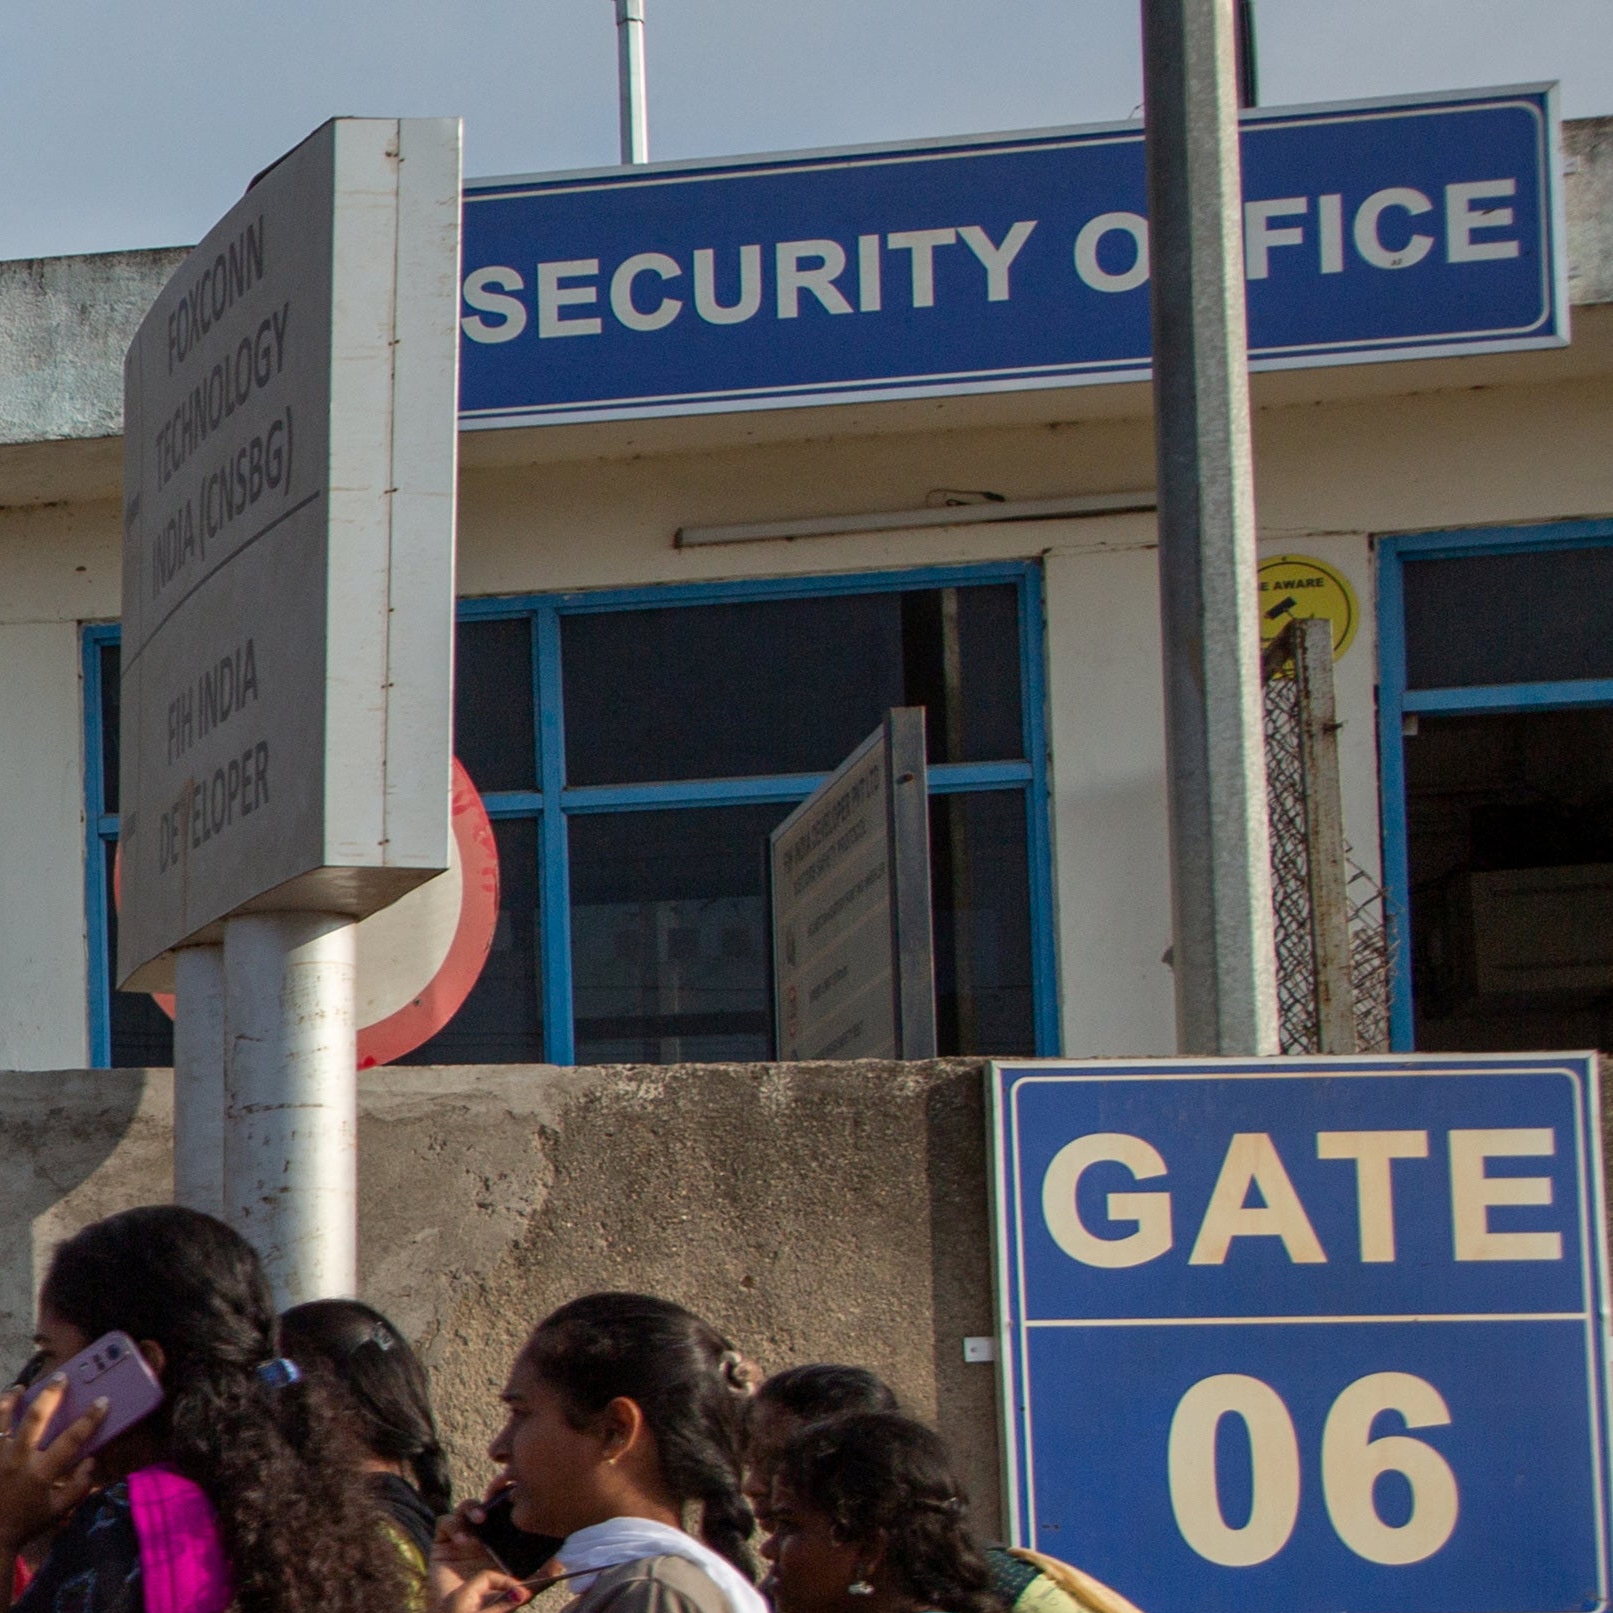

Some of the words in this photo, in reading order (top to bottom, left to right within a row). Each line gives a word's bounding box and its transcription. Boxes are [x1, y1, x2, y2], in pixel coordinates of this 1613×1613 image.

[169, 215, 264, 376] FOXCONN
[460, 220, 1037, 343] SECURITY
[1073, 178, 1520, 292] OFICE
[156, 302, 289, 493] TECHNOLOGY
[153, 499, 194, 600] INDIA
[199, 405, 293, 562] (CNSBG)
[1274, 578, 1324, 590] AWARE
[168, 686, 193, 766] FIH
[198, 638, 258, 739] INDIA
[1042, 1128, 1563, 1268] GATE
[1168, 1372, 1459, 1567] 06
